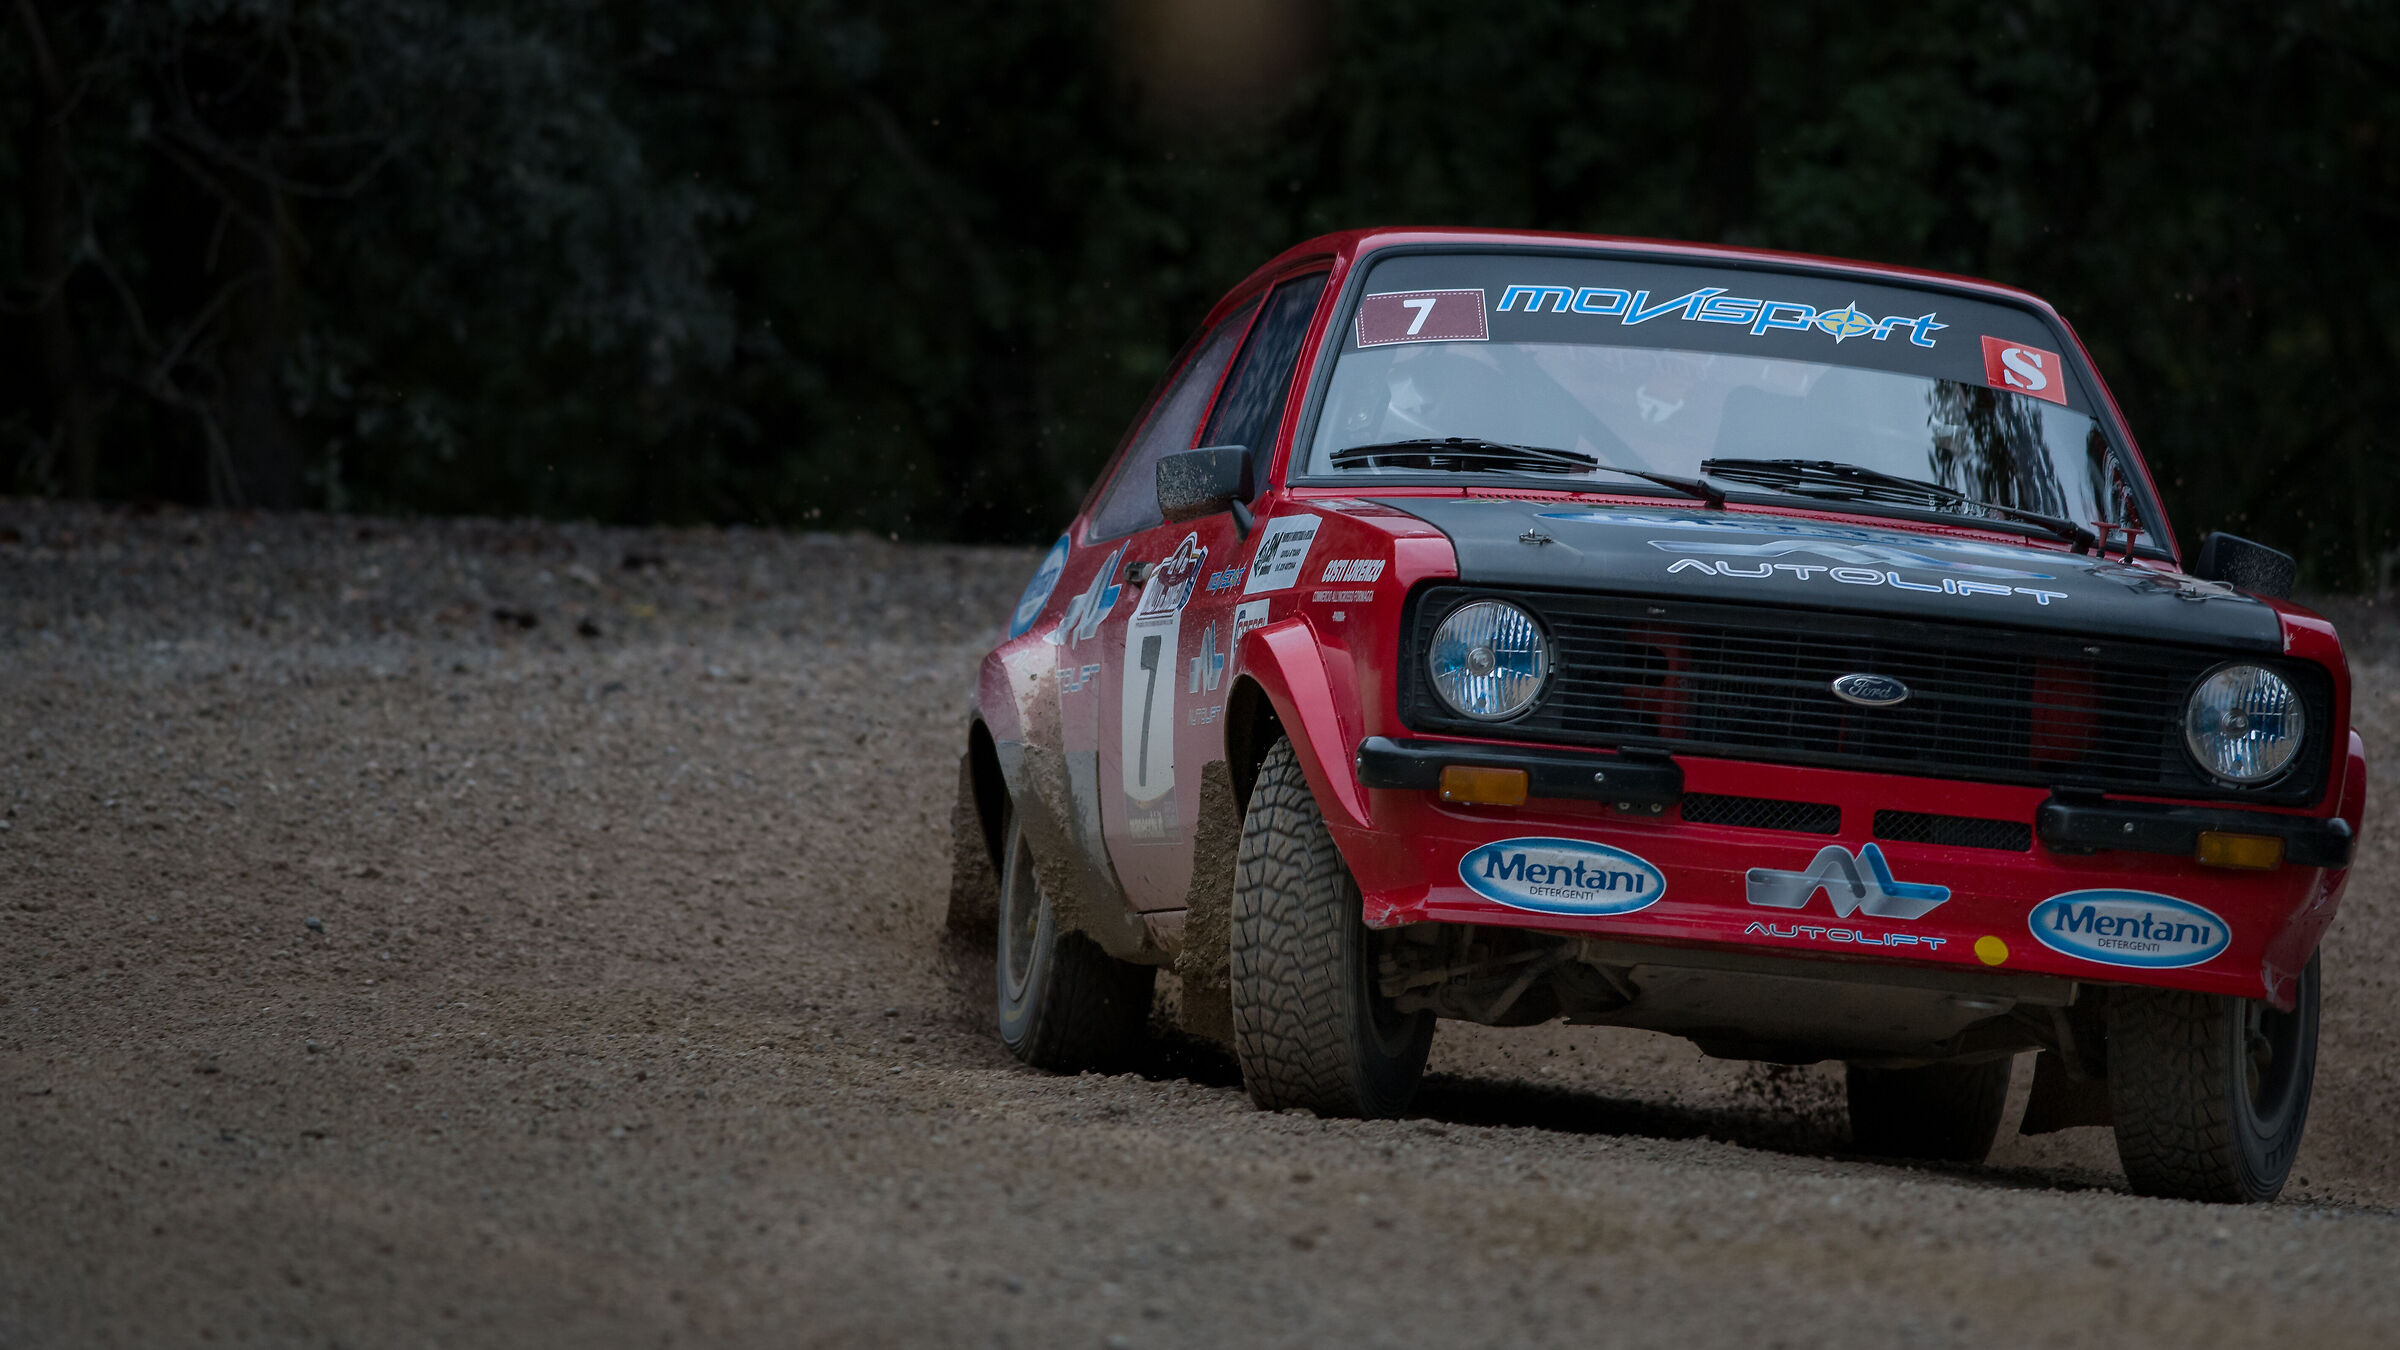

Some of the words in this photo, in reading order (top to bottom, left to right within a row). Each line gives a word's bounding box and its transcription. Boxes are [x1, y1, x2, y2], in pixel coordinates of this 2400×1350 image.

[1402, 299, 1430, 335] 7
[2000, 348, 2047, 391] S
[1666, 558, 2069, 606] AUTOLIFT
[1848, 678, 1894, 698] Ford
[1139, 635, 1162, 787] 7
[1482, 850, 1645, 893] Mentani
[1529, 885, 1594, 902] DETERGENTI
[1744, 921, 1947, 951] AUTOLIFT
[2051, 902, 2212, 947] Mentani
[2097, 936, 2161, 954] DETERGENTI
